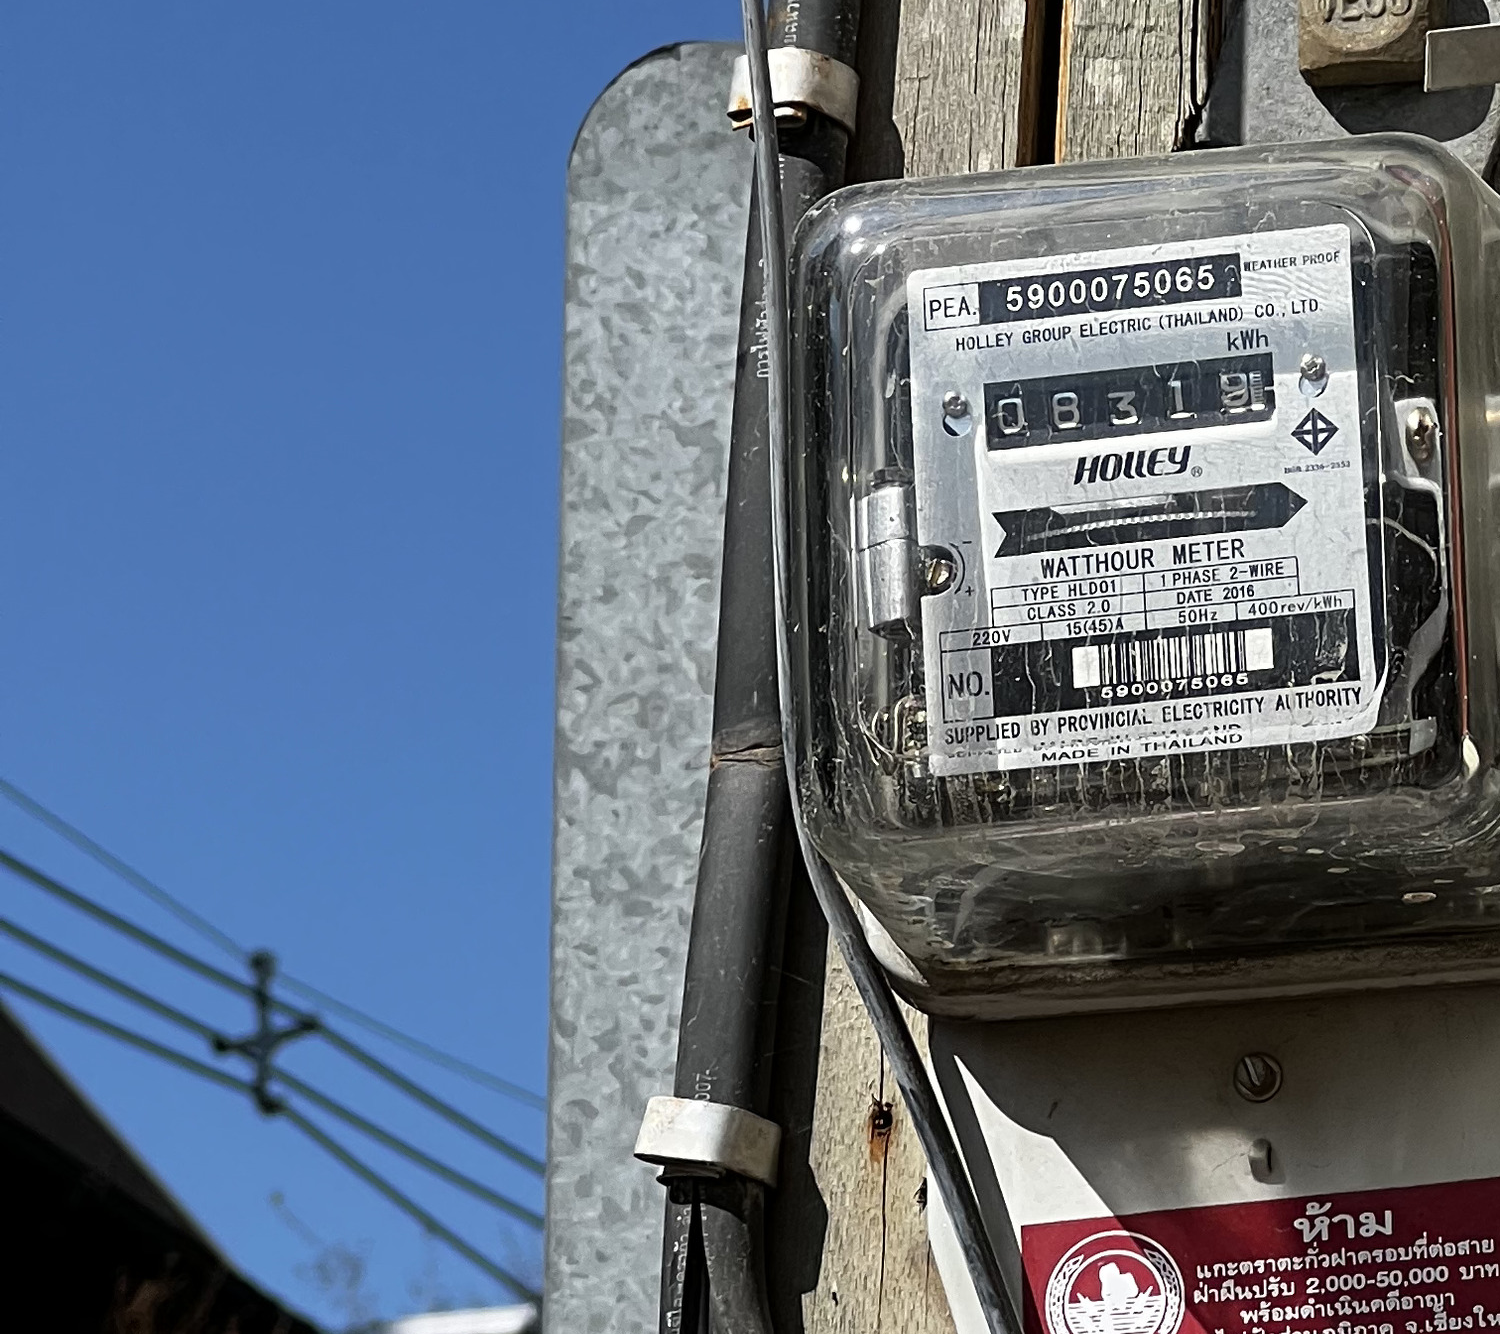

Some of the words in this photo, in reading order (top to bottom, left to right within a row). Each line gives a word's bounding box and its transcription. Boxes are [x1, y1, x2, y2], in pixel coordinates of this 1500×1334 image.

[1243, 258, 1297, 272] WEATHER
[1302, 251, 1340, 267] PROOF
[928, 297, 978, 321] PEA.
[1005, 264, 1216, 313] 5900075065
[955, 332, 1014, 352] HOLLEY
[1021, 326, 1072, 345] GROUP
[1079, 319, 1151, 338] ELECTRIC
[1158, 306, 1244, 334] (THAILAND)
[1226, 331, 1269, 351] kWh
[1040, 547, 1155, 579] WATTHOUR
[1172, 538, 1245, 566] METER
[1160, 573, 1167, 587] 1
[1171, 568, 1222, 586] PHASE
[1229, 561, 1285, 580] 2-WIRE
[1021, 584, 1058, 601] TYPE
[1176, 588, 1214, 605] DATE
[1222, 584, 1255, 600] 2016
[1248, 594, 1343, 617] 400rev/kWh
[1027, 603, 1081, 621] CLASS
[1086, 599, 1111, 615] 2.0
[1177, 607, 1219, 624] 50Hz
[971, 629, 1011, 646] 220V
[1065, 618, 1125, 636] 15(45)A
[947, 671, 991, 699] NO.
[1101, 672, 1250, 700] 5900075065
[944, 723, 1022, 746] SUPPLIED
[1030, 718, 1050, 737] BY
[1162, 696, 1265, 724] ELECTRICITY
[1041, 744, 1100, 763] MADE
[1111, 743, 1131, 757] IN
[1141, 731, 1244, 753] THAILAND
[1293, 1201, 1393, 1243] ห้าม
[1195, 1231, 1495, 1279] แกะตราตะกั่วฝาครอบที่ต่อสาย
[1305, 1264, 1449, 1296] 2,000-50,000
[1458, 1262, 1500, 1281] บาท
[1239, 1289, 1456, 1324] พร้อมดำเนินคดีอาญา
